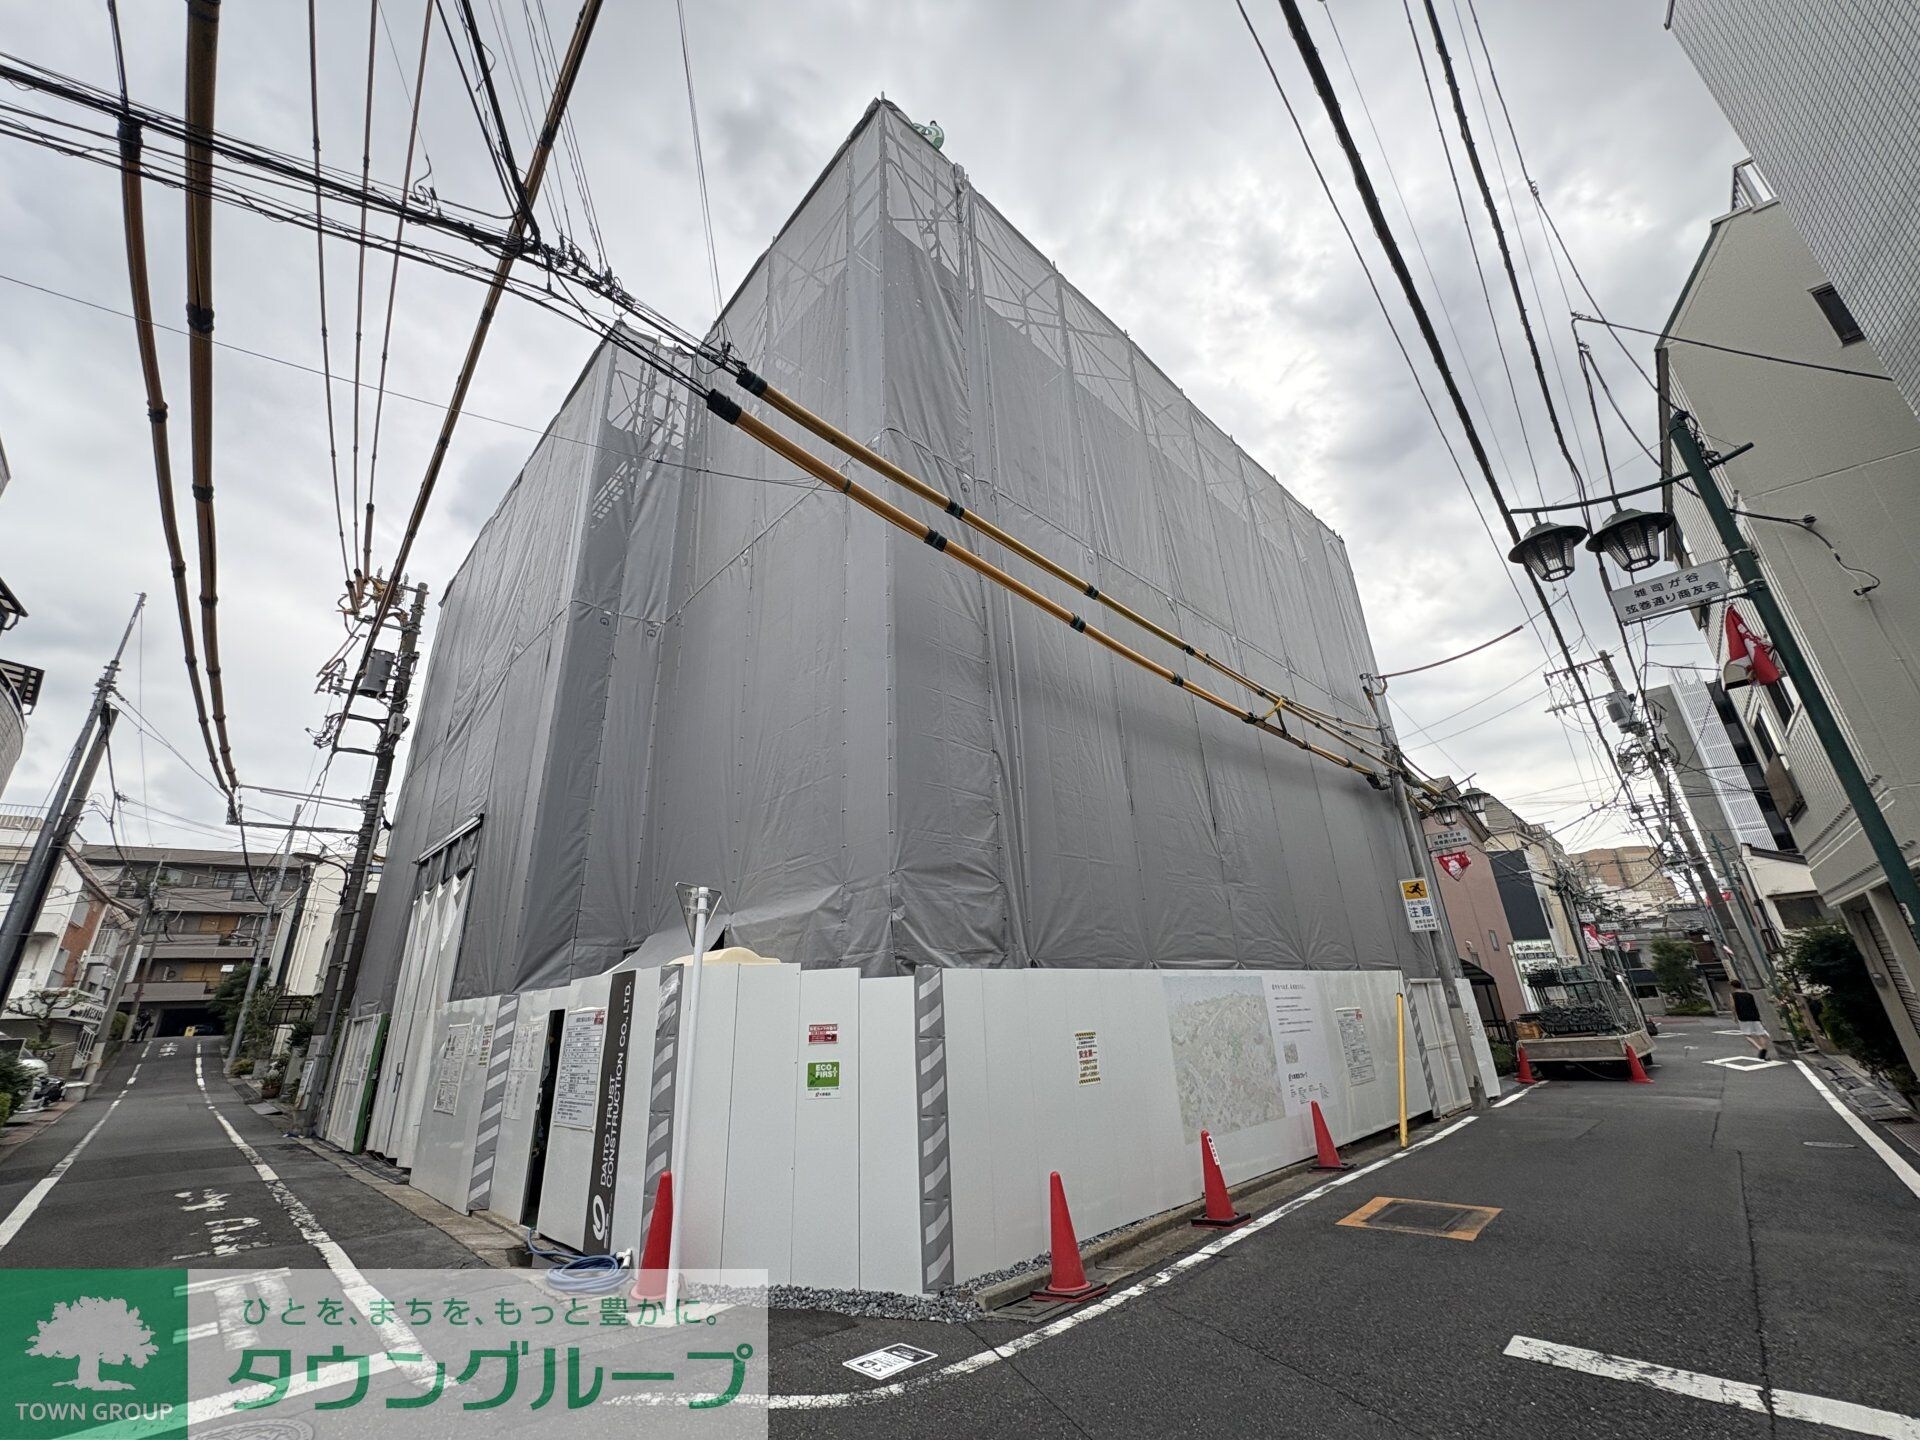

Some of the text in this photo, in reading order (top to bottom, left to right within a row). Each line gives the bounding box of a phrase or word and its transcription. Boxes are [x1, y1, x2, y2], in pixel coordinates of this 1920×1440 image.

[1625, 580, 1721, 615] 弦巻通り商友会
[1633, 572, 1700, 598] 雑司が谷
[1408, 905, 1432, 918] 注意
[607, 1052, 624, 1188] CONSTRUCTION
[623, 981, 632, 1014] LTD.
[815, 1067, 837, 1078] FIRST
[600, 1074, 615, 1186] DAITO TRUST
